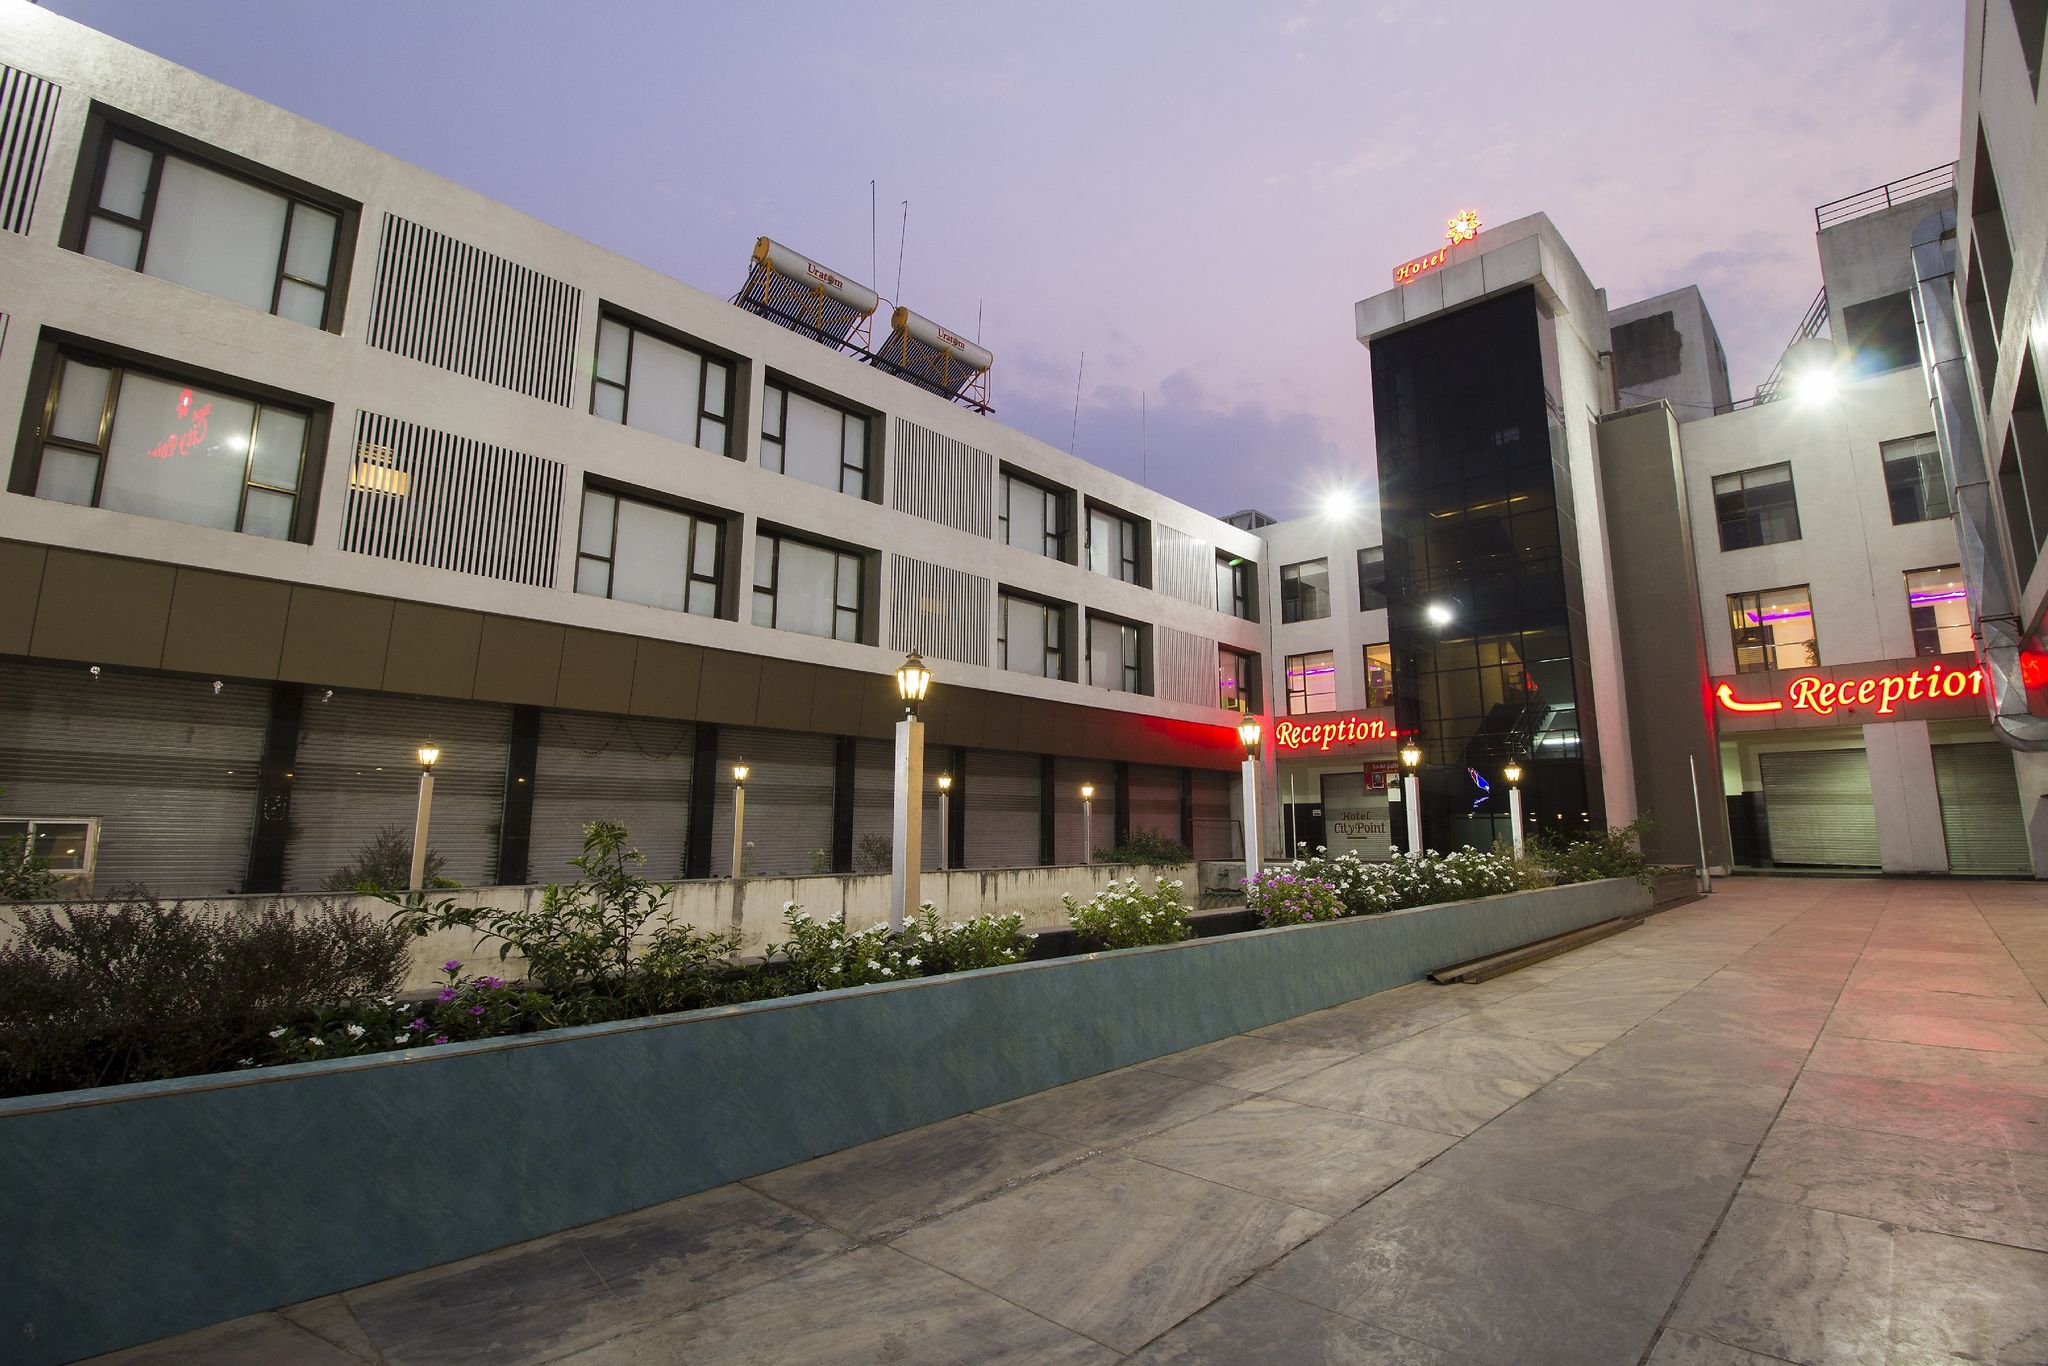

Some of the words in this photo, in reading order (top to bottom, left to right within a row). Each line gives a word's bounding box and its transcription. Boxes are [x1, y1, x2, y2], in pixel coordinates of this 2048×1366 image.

[1396, 247, 1447, 282] Hotel
[1276, 717, 1386, 751] Reception
[1341, 811, 1371, 821] Hotel
